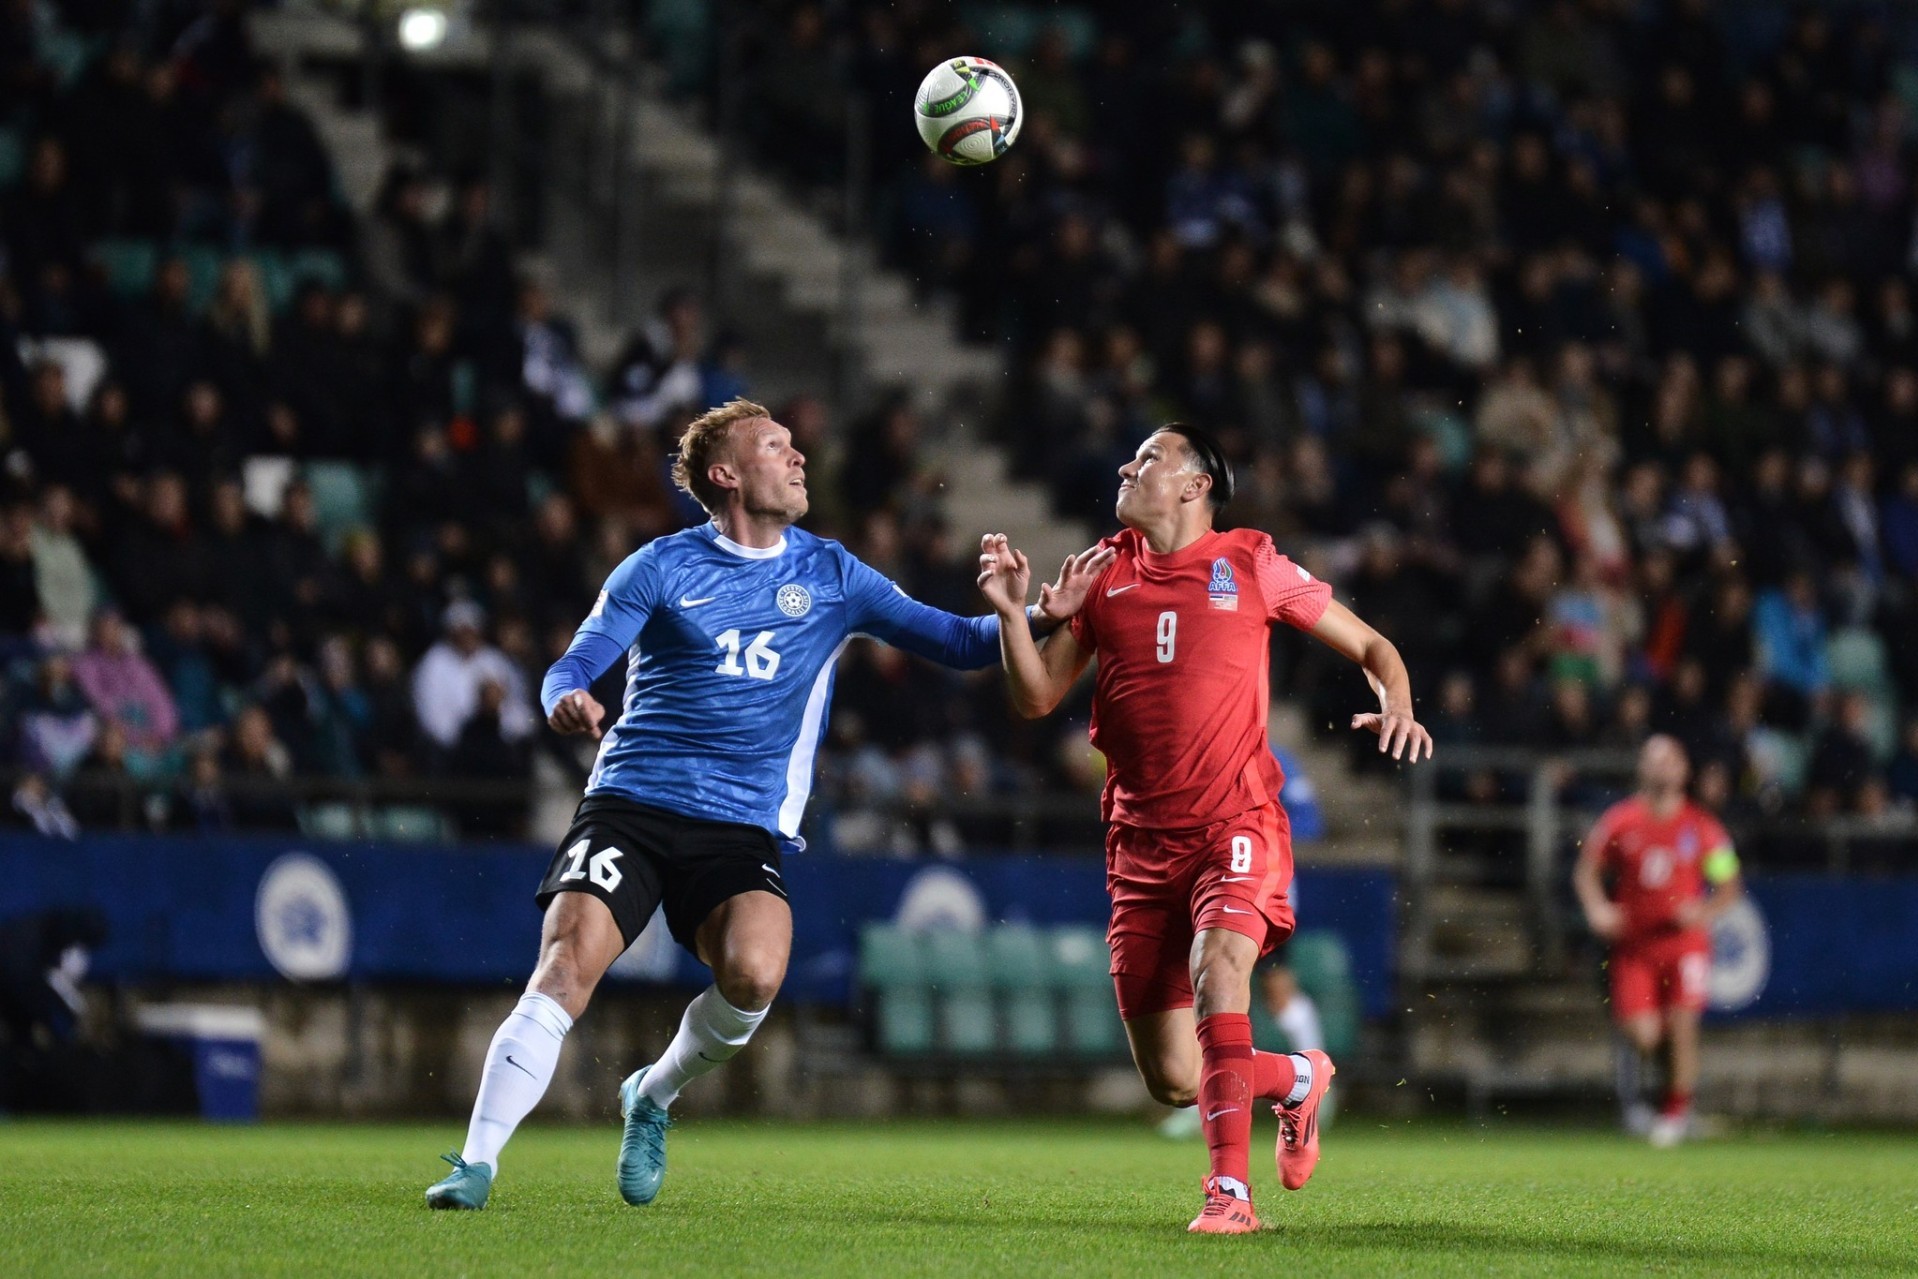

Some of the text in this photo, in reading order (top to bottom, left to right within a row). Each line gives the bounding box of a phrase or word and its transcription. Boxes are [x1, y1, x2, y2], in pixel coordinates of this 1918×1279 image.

[1208, 581, 1236, 592] AFFA
[714, 628, 781, 681] 16
[1156, 610, 1177, 663] 9
[559, 838, 624, 893] 16
